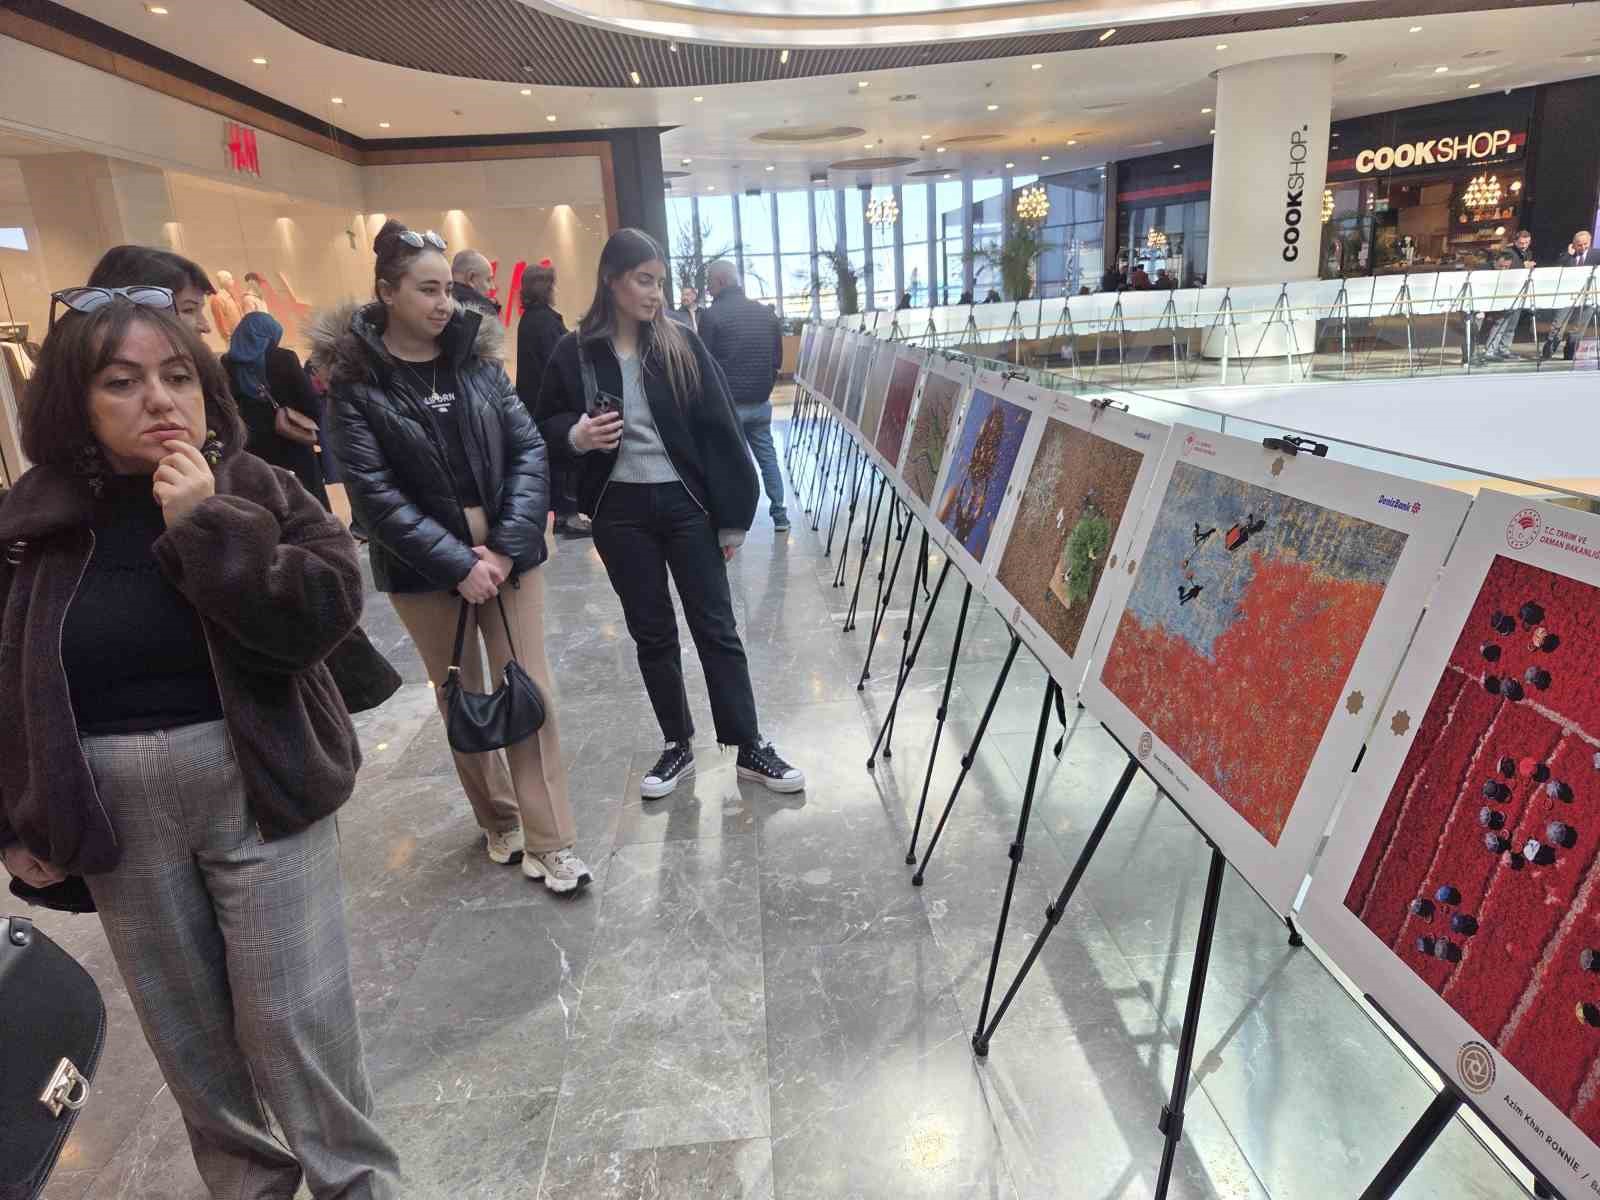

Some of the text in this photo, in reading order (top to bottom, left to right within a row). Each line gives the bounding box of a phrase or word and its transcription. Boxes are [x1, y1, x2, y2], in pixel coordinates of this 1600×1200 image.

[1355, 129, 1517, 173] COOKSHOP.
[1379, 495, 1410, 511] DenizBank
[1540, 535, 1565, 549] ORMAN
[1503, 1094, 1524, 1117] Azim
[1524, 1113, 1545, 1138] Khan
